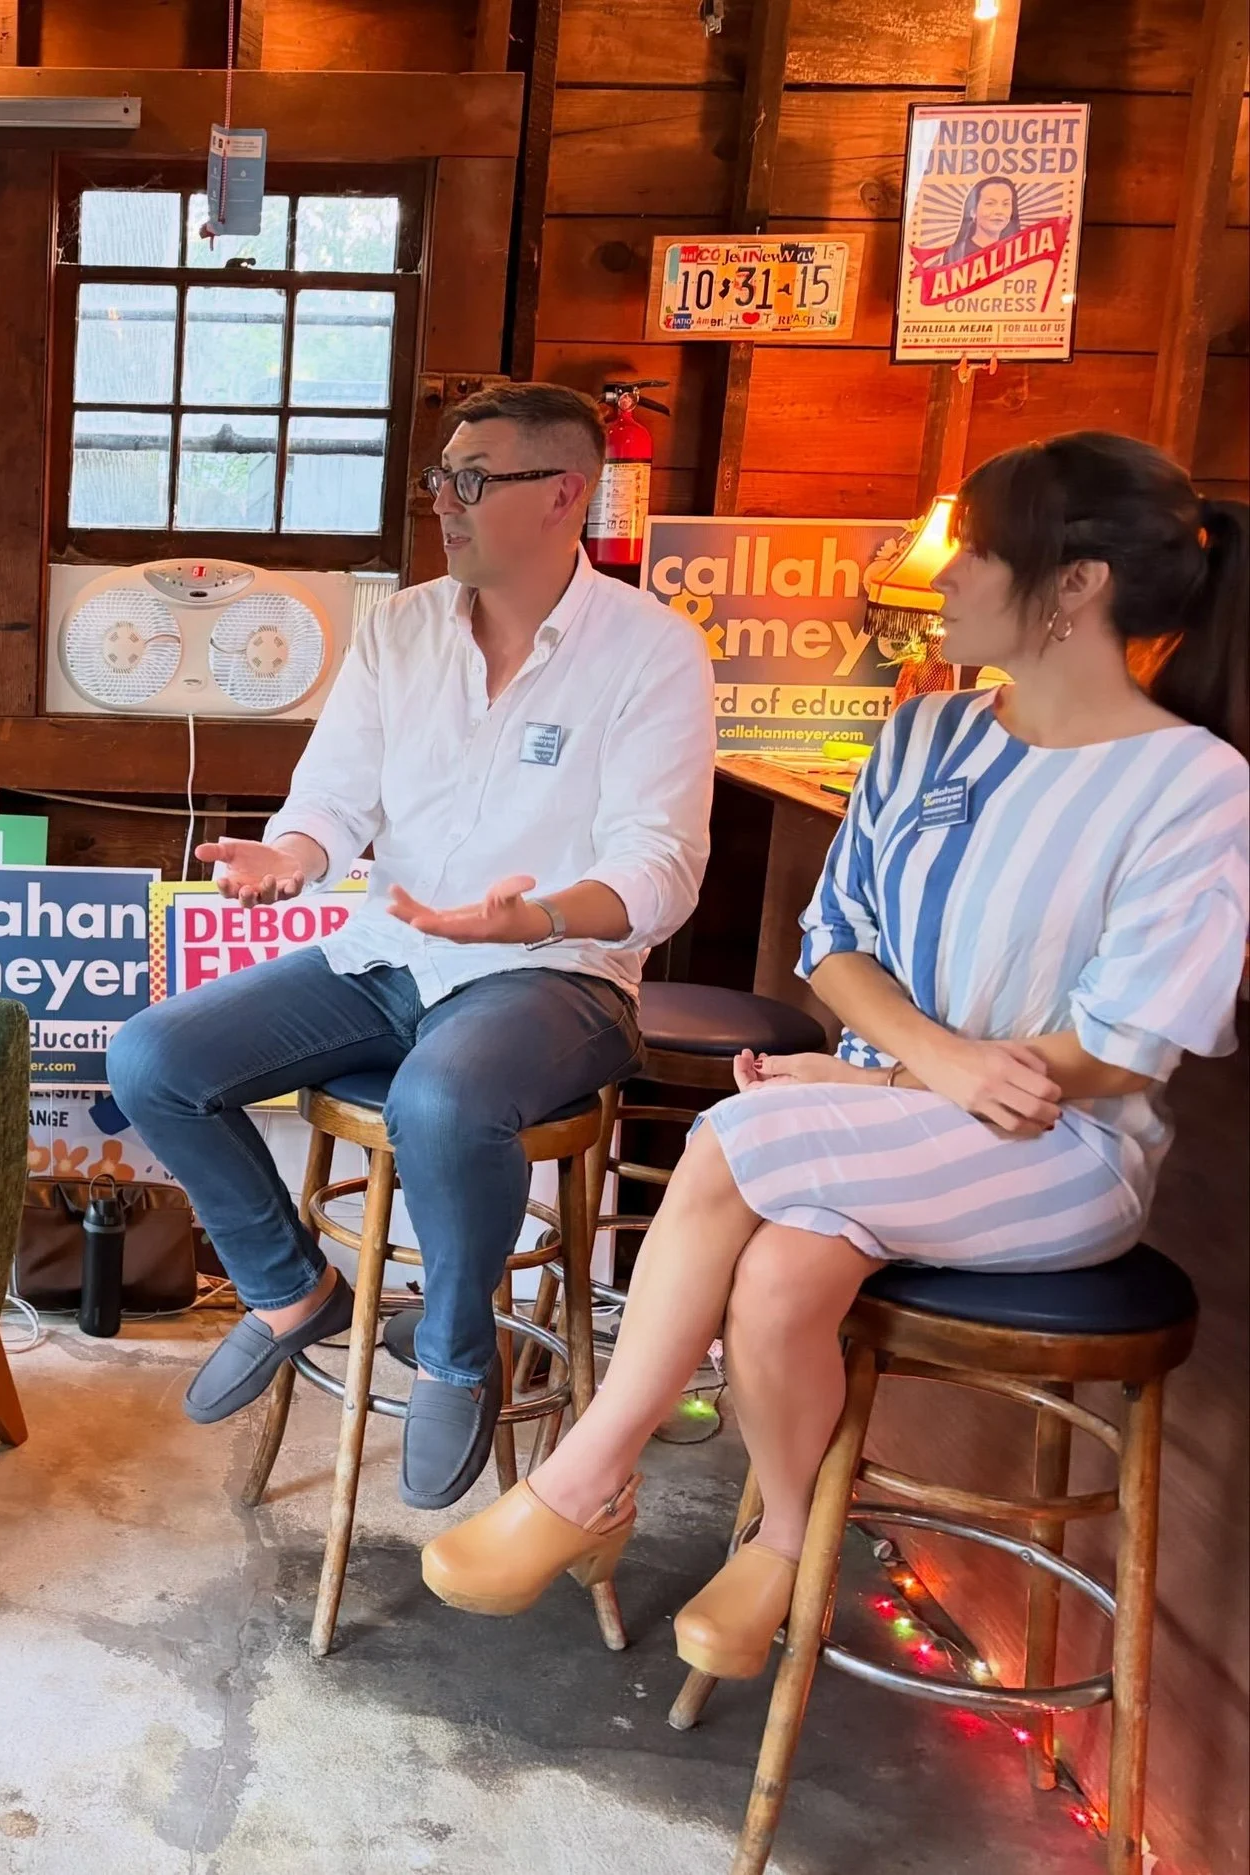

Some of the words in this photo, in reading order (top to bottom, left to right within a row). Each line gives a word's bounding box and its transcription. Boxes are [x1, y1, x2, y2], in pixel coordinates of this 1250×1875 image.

[919, 119, 1081, 145] NBOUGHT
[931, 226, 1056, 299] ANALILIA
[797, 265, 832, 308] 15
[1003, 279, 1037, 294] FOR
[945, 298, 1036, 313] CONGRESS
[903, 325, 956, 333] ANALILIA
[959, 324, 993, 333] MEJIA
[1003, 323, 1020, 332] FOR
[1023, 323, 1038, 332] ALL
[1040, 323, 1052, 332] OF
[1054, 323, 1065, 332] US
[751, 687, 780, 715] of
[719, 725, 864, 744] callahanmeyer.com
